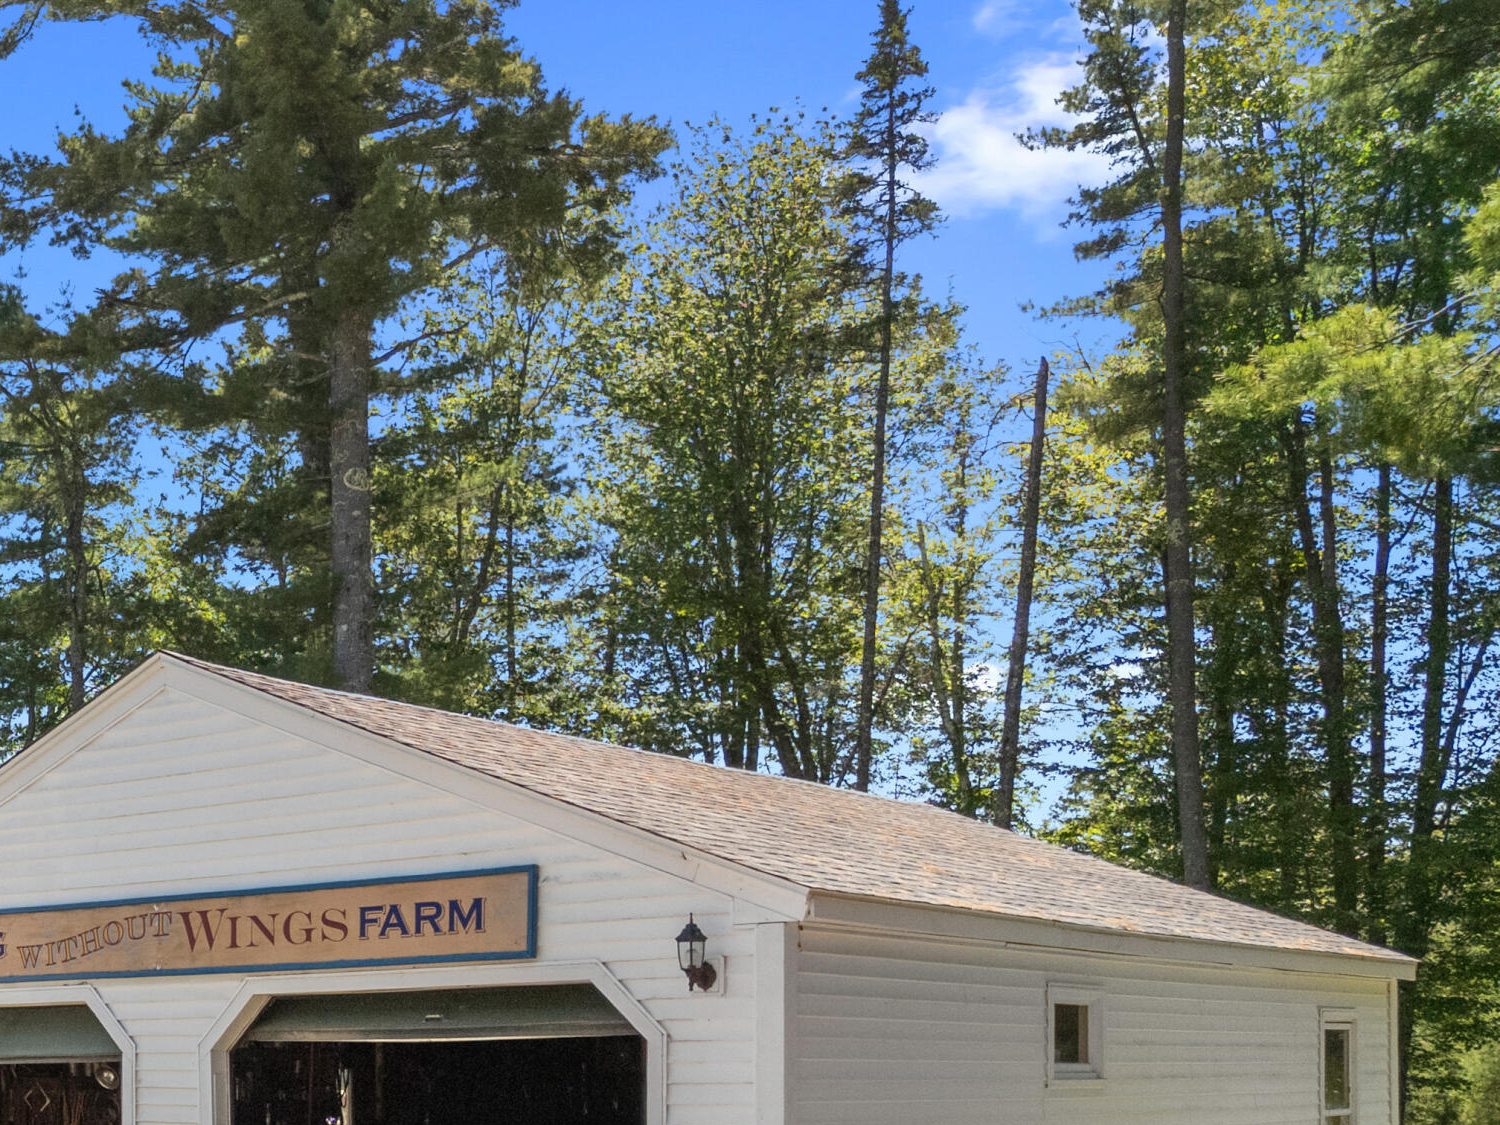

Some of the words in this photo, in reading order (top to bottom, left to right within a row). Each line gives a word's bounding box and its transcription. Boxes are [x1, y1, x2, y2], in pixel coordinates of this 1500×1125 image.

[16, 910, 172, 969] WITHOUT
[177, 907, 349, 952] WINGS
[358, 897, 487, 940] FARM
